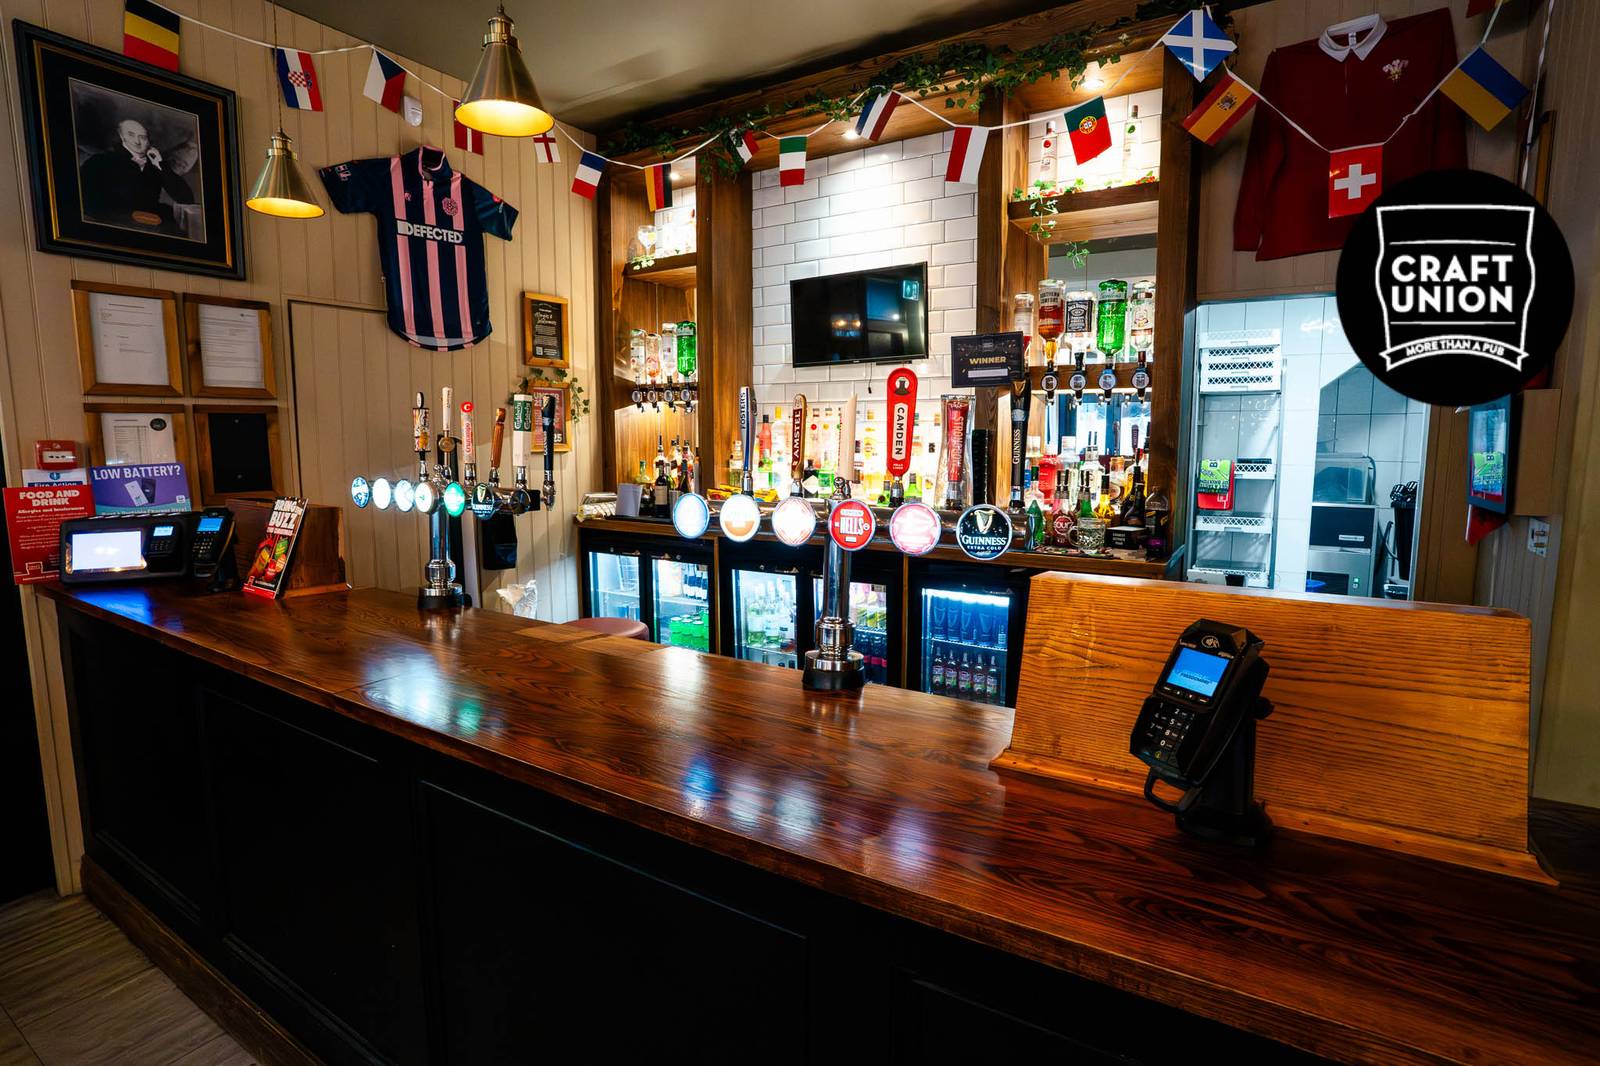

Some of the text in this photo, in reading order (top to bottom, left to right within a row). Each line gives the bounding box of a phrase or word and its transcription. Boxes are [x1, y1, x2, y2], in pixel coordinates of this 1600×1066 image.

[397, 220, 463, 244] DEFECTED
[969, 356, 1007, 365] WINNER
[793, 410, 801, 458] AMSTEL
[895, 407, 905, 455] CAMDEN
[1013, 428, 1021, 465] GUINNESS
[93, 465, 181, 480] LOW BATTERY?
[19, 489, 80, 500] FOOD AND
[32, 497, 70, 507] DRINK
[268, 510, 299, 530] BUZZ
[840, 516, 864, 535] HELLS
[962, 534, 1007, 546] GUINNESS
